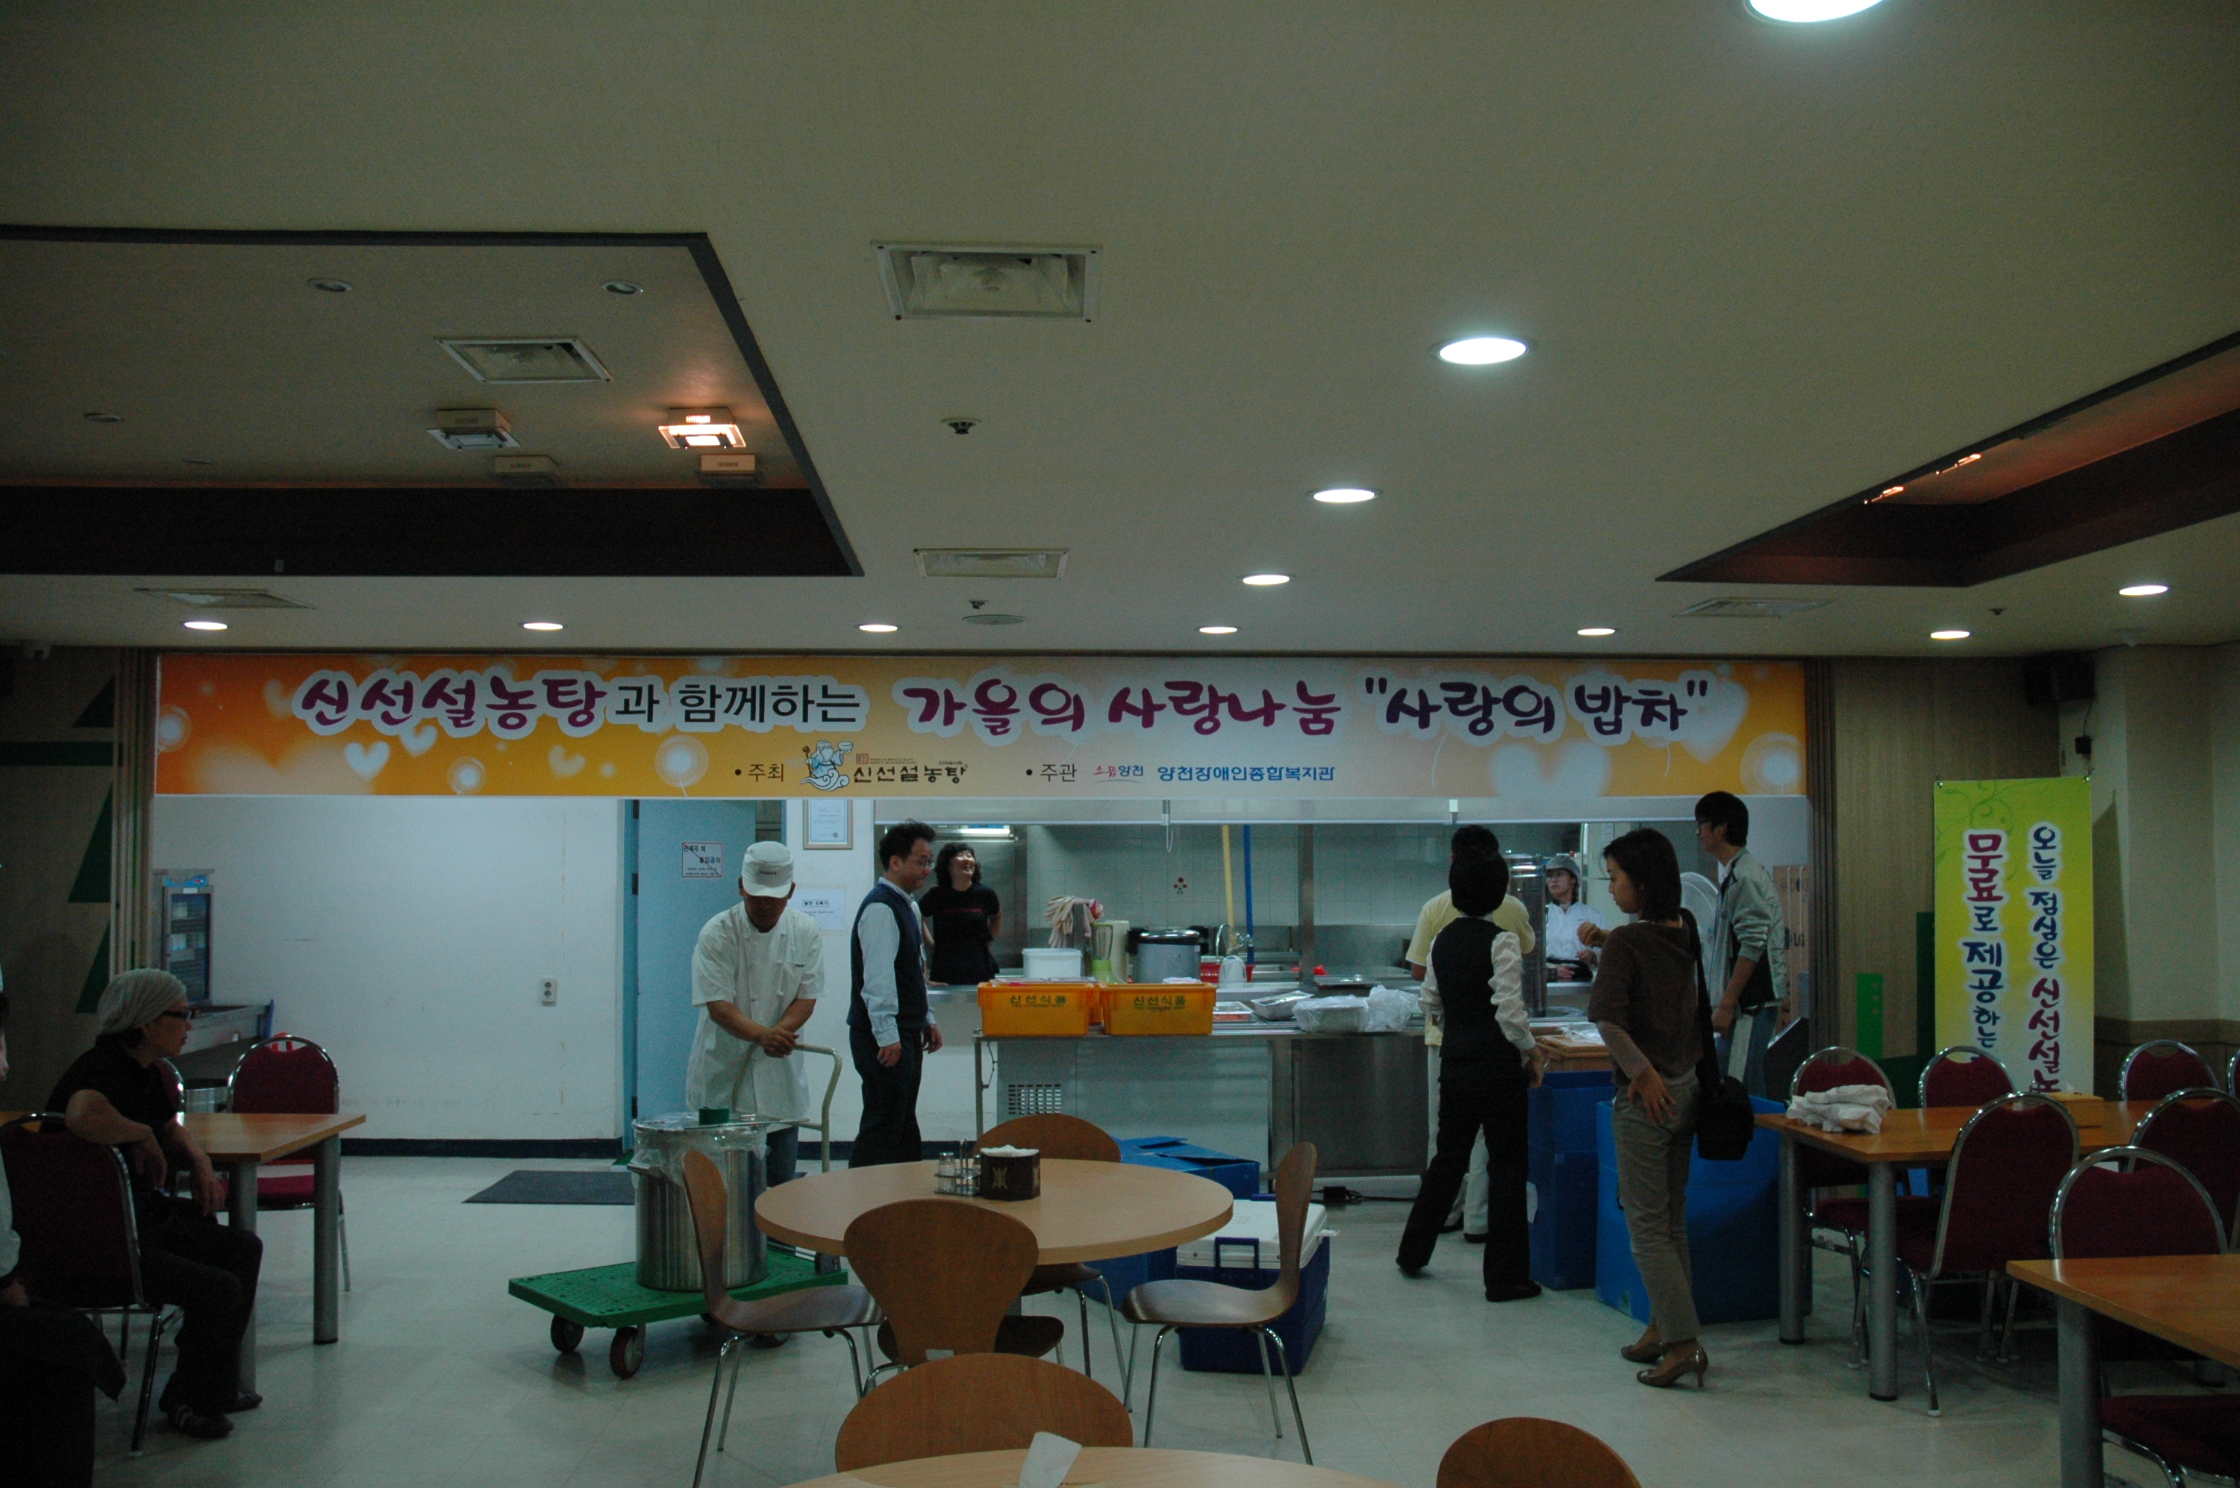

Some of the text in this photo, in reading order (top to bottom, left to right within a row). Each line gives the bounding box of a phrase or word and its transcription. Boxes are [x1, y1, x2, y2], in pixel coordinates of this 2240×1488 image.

[678, 684, 860, 723] 함께하는
[902, 678, 1085, 735] 가을의
[1108, 680, 1342, 735] 사랑나눔
[1365, 677, 1556, 736] "사랑의
[1574, 679, 1708, 735] 밥차"
[747, 763, 967, 784] 주최 신선설농탕
[1040, 763, 1077, 783] 주관
[1157, 765, 1335, 782] 양천장애인종합복지관
[2033, 826, 2057, 880] 오늘
[1963, 833, 2003, 1048] 무료로 제공하는
[2029, 892, 2058, 969] 점심은
